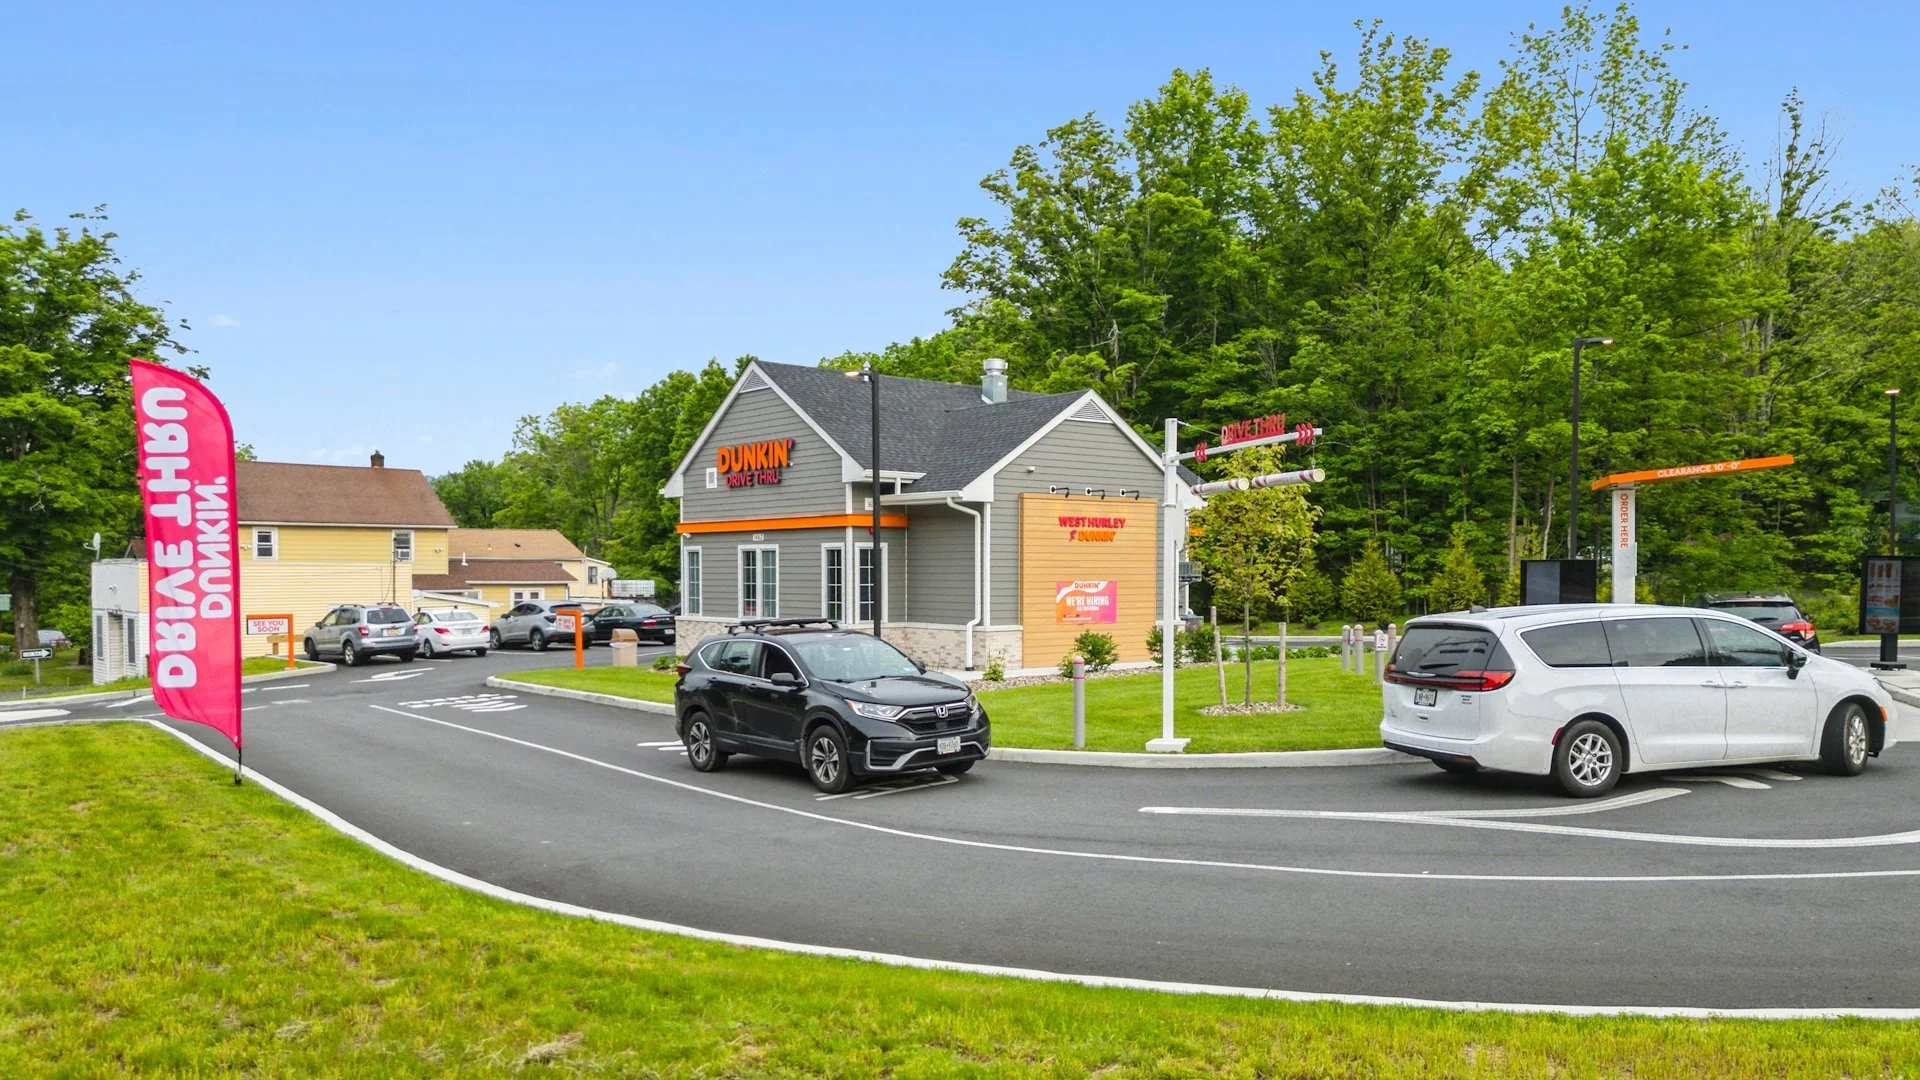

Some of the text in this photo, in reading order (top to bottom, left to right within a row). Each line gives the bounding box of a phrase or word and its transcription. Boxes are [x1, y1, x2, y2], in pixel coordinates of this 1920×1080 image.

[1221, 413, 1286, 441] DRIVE THRU
[717, 438, 794, 474] DUNKIN'
[725, 469, 780, 487] DRIVE THRU
[1657, 465, 1711, 478] CLEARANCE
[1058, 516, 1126, 528] WEST HURLEY
[1620, 493, 1629, 549] ORDER HERE
[1086, 595, 1109, 606] HIRING
